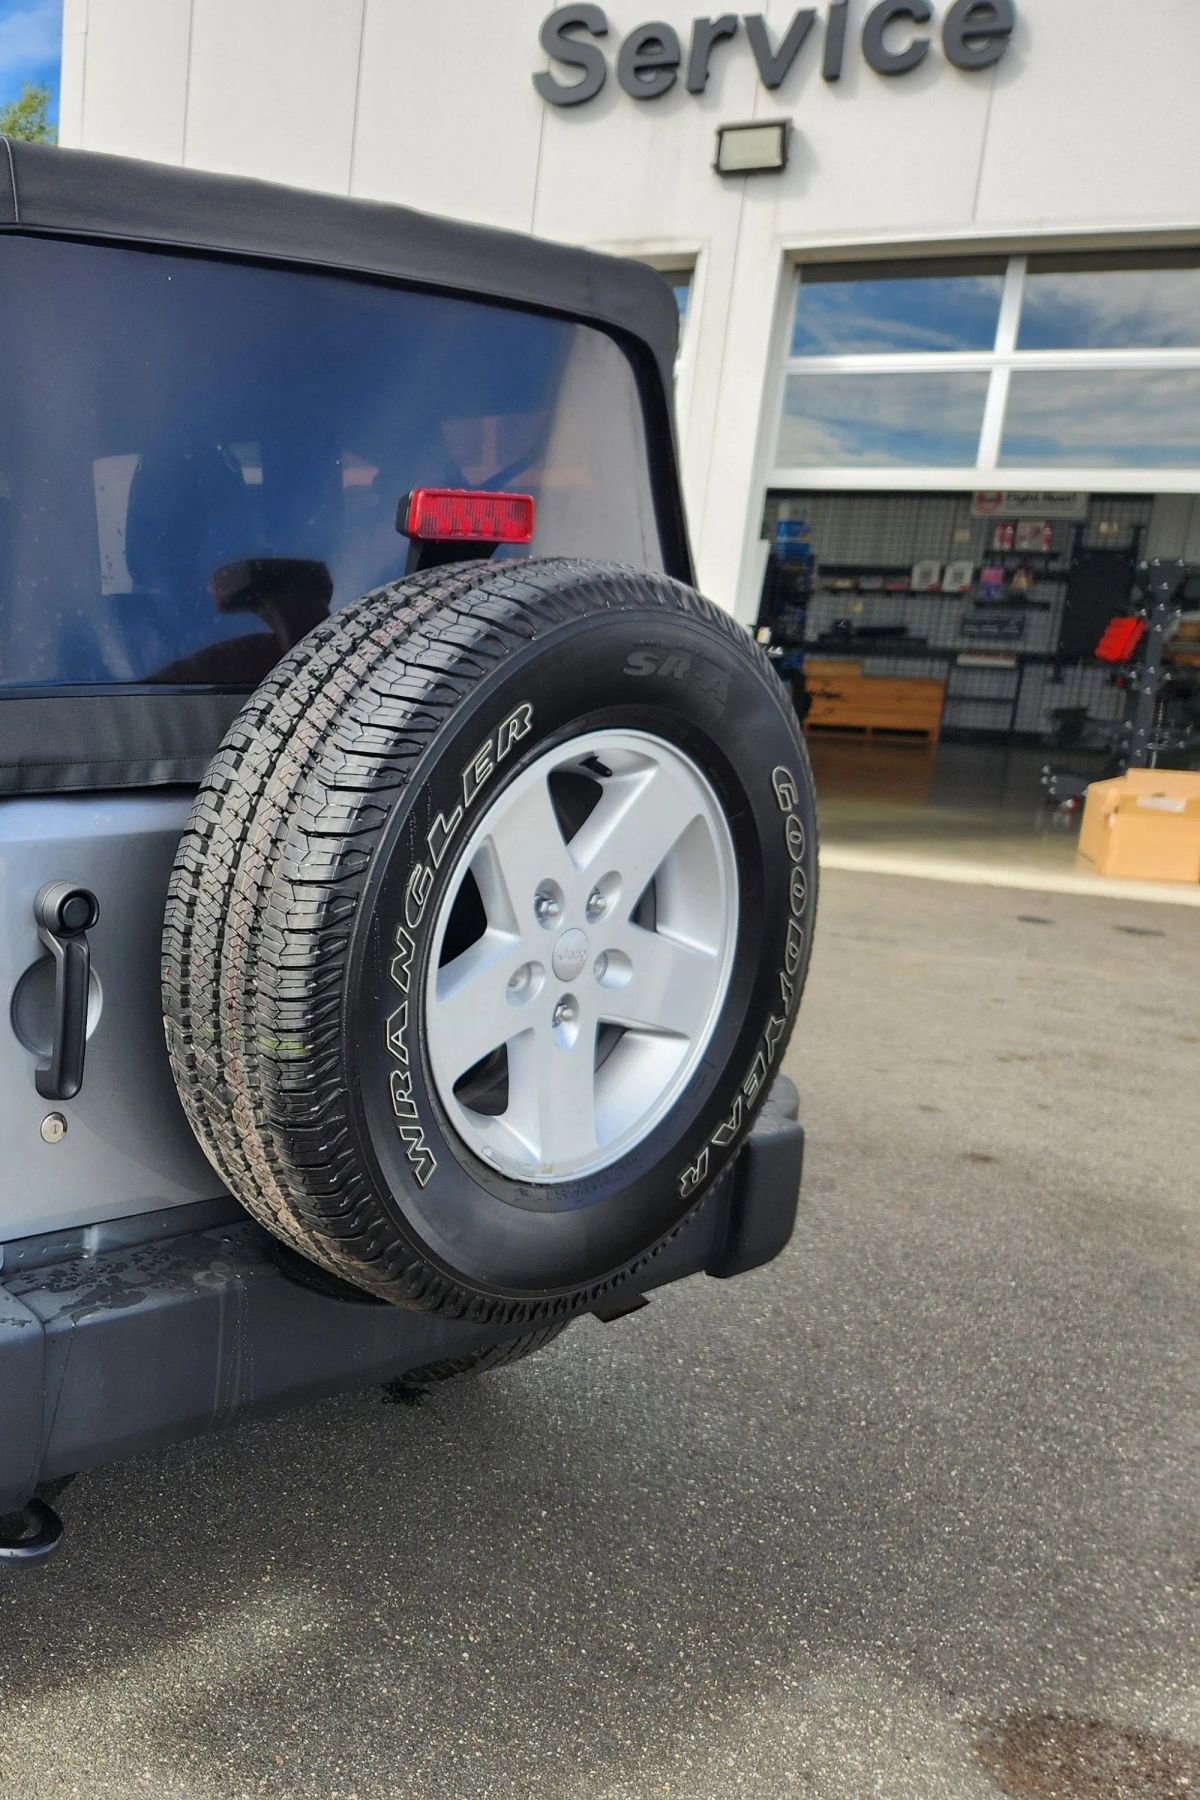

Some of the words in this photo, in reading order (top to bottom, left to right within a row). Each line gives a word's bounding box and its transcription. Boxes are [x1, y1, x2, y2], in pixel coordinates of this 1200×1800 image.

[532, 0, 1017, 107] Service
[386, 702, 534, 1189] WRANGLER
[678, 765, 807, 1198] GOODYEAR
